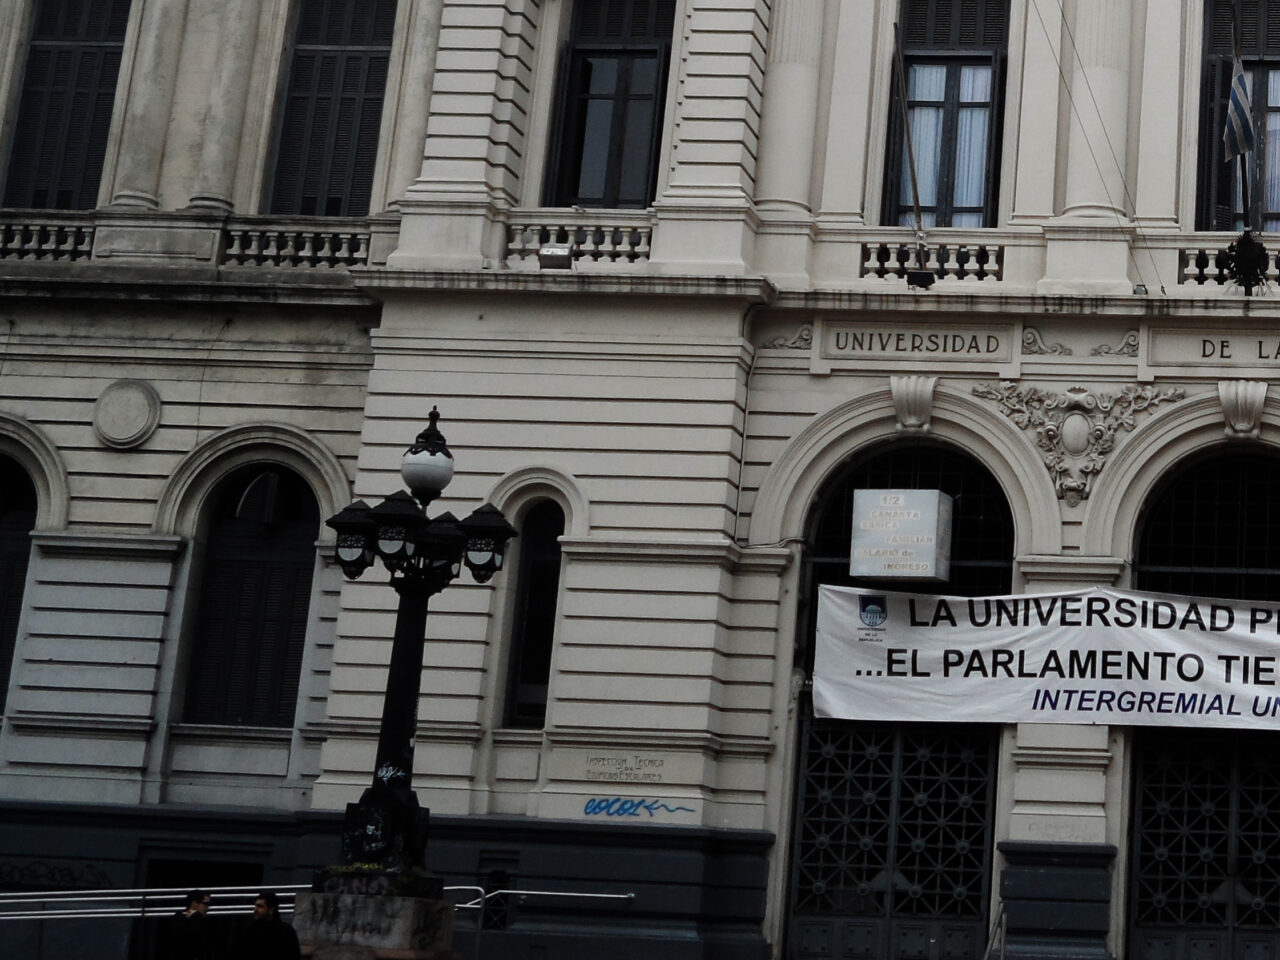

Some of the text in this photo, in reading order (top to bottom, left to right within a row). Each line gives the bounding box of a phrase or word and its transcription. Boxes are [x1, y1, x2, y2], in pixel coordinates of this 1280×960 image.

[835, 332, 1001, 353] UNIVERSIDAD
[1201, 339, 1232, 358] DE
[882, 495, 900, 504] 1/2
[908, 597, 958, 628] LA
[968, 596, 1235, 632] UNIVERSIDAD
[855, 648, 931, 678] ...EL
[943, 649, 1205, 683] PARLAMENTO
[1032, 688, 1242, 716] INTERGREMIAL
